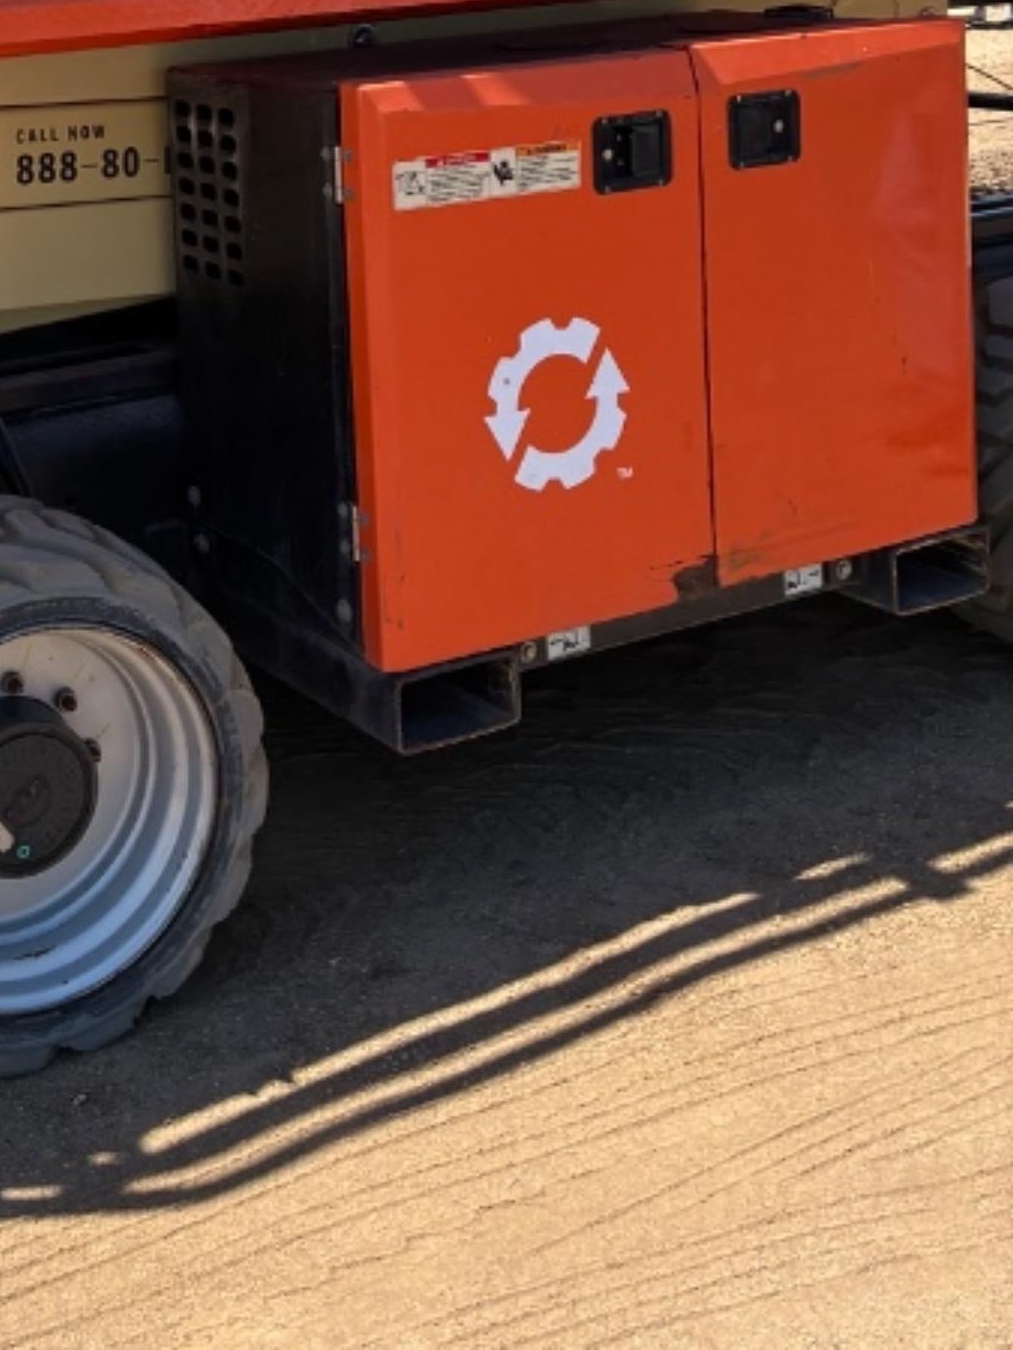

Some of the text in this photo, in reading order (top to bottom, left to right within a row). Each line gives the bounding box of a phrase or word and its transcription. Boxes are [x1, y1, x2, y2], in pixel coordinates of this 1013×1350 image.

[16, 125, 105, 144] CALL NOW
[16, 146, 171, 185] 888-80-
